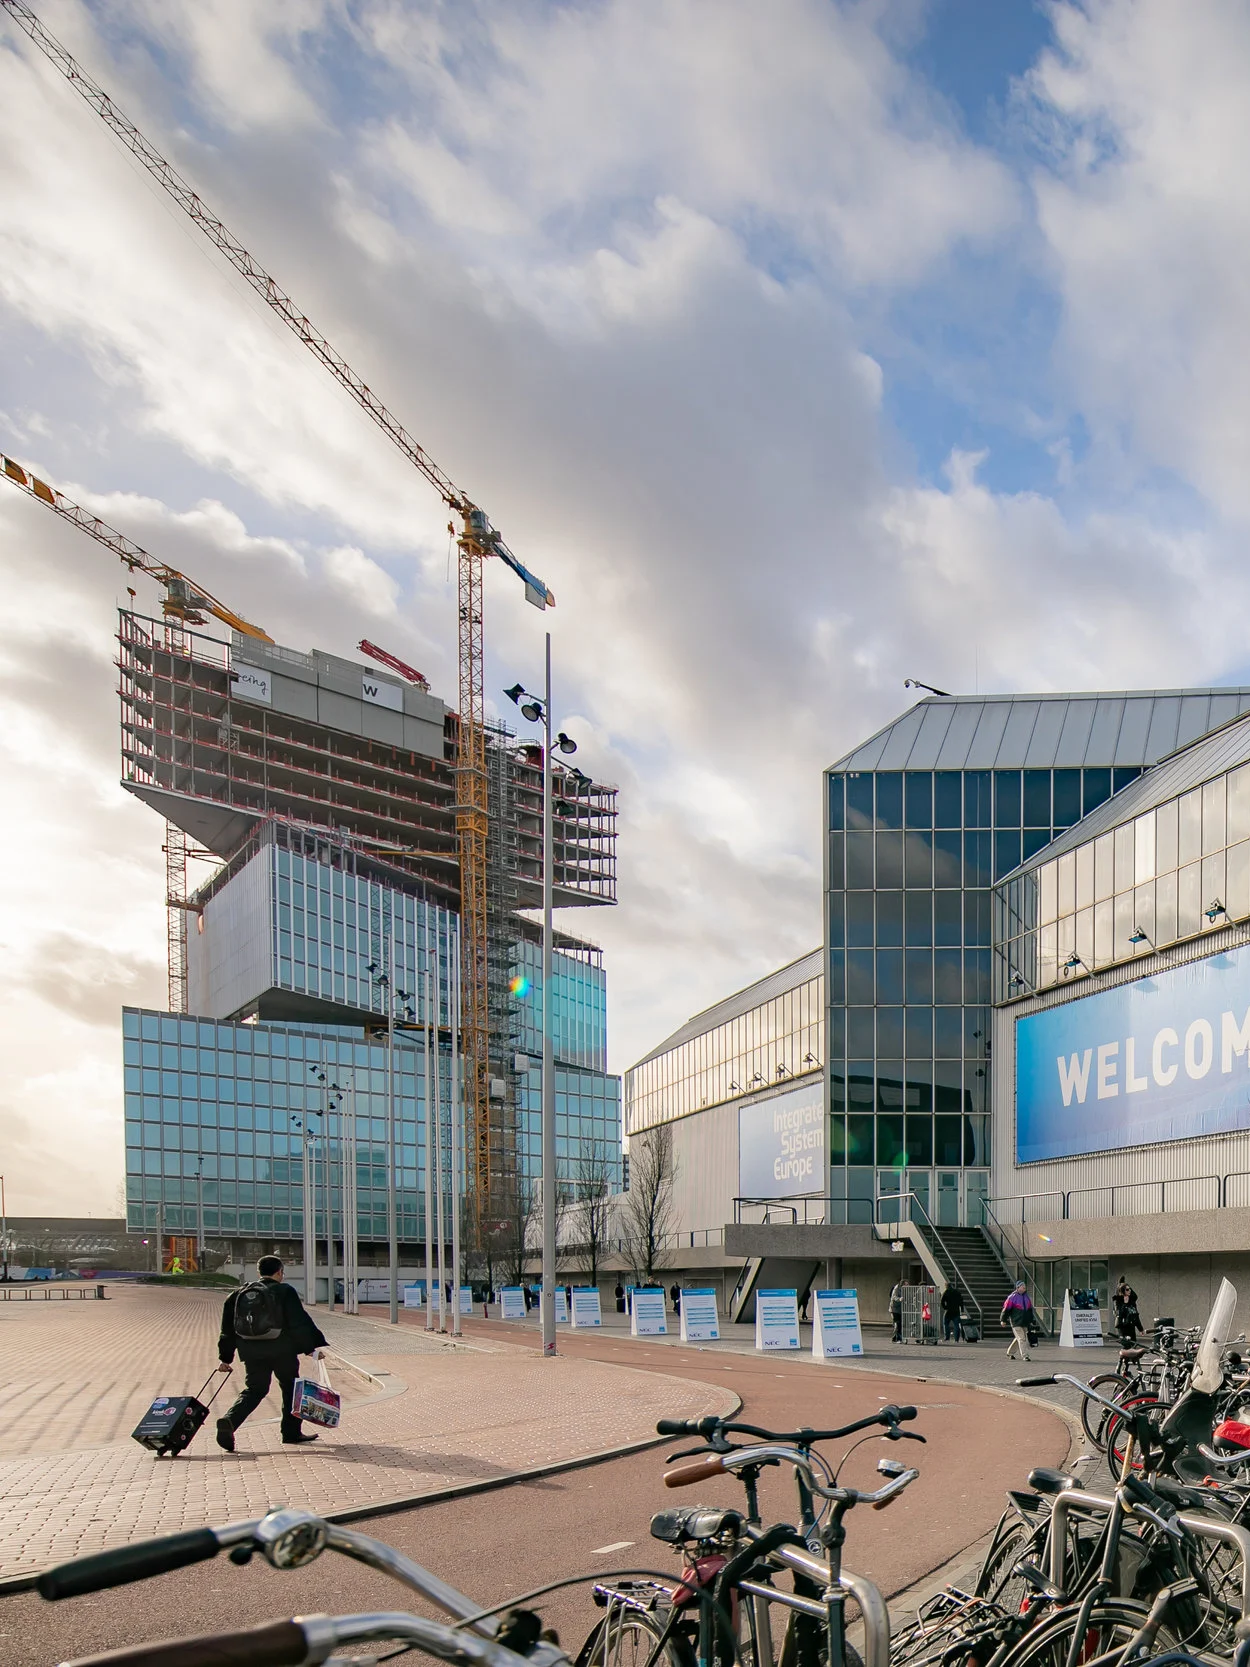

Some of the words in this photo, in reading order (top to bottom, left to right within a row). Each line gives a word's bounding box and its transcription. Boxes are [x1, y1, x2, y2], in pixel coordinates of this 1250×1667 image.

[774, 1101, 824, 1133] Integrate
[781, 1128, 824, 1158] System
[773, 1156, 813, 1182] Europe
